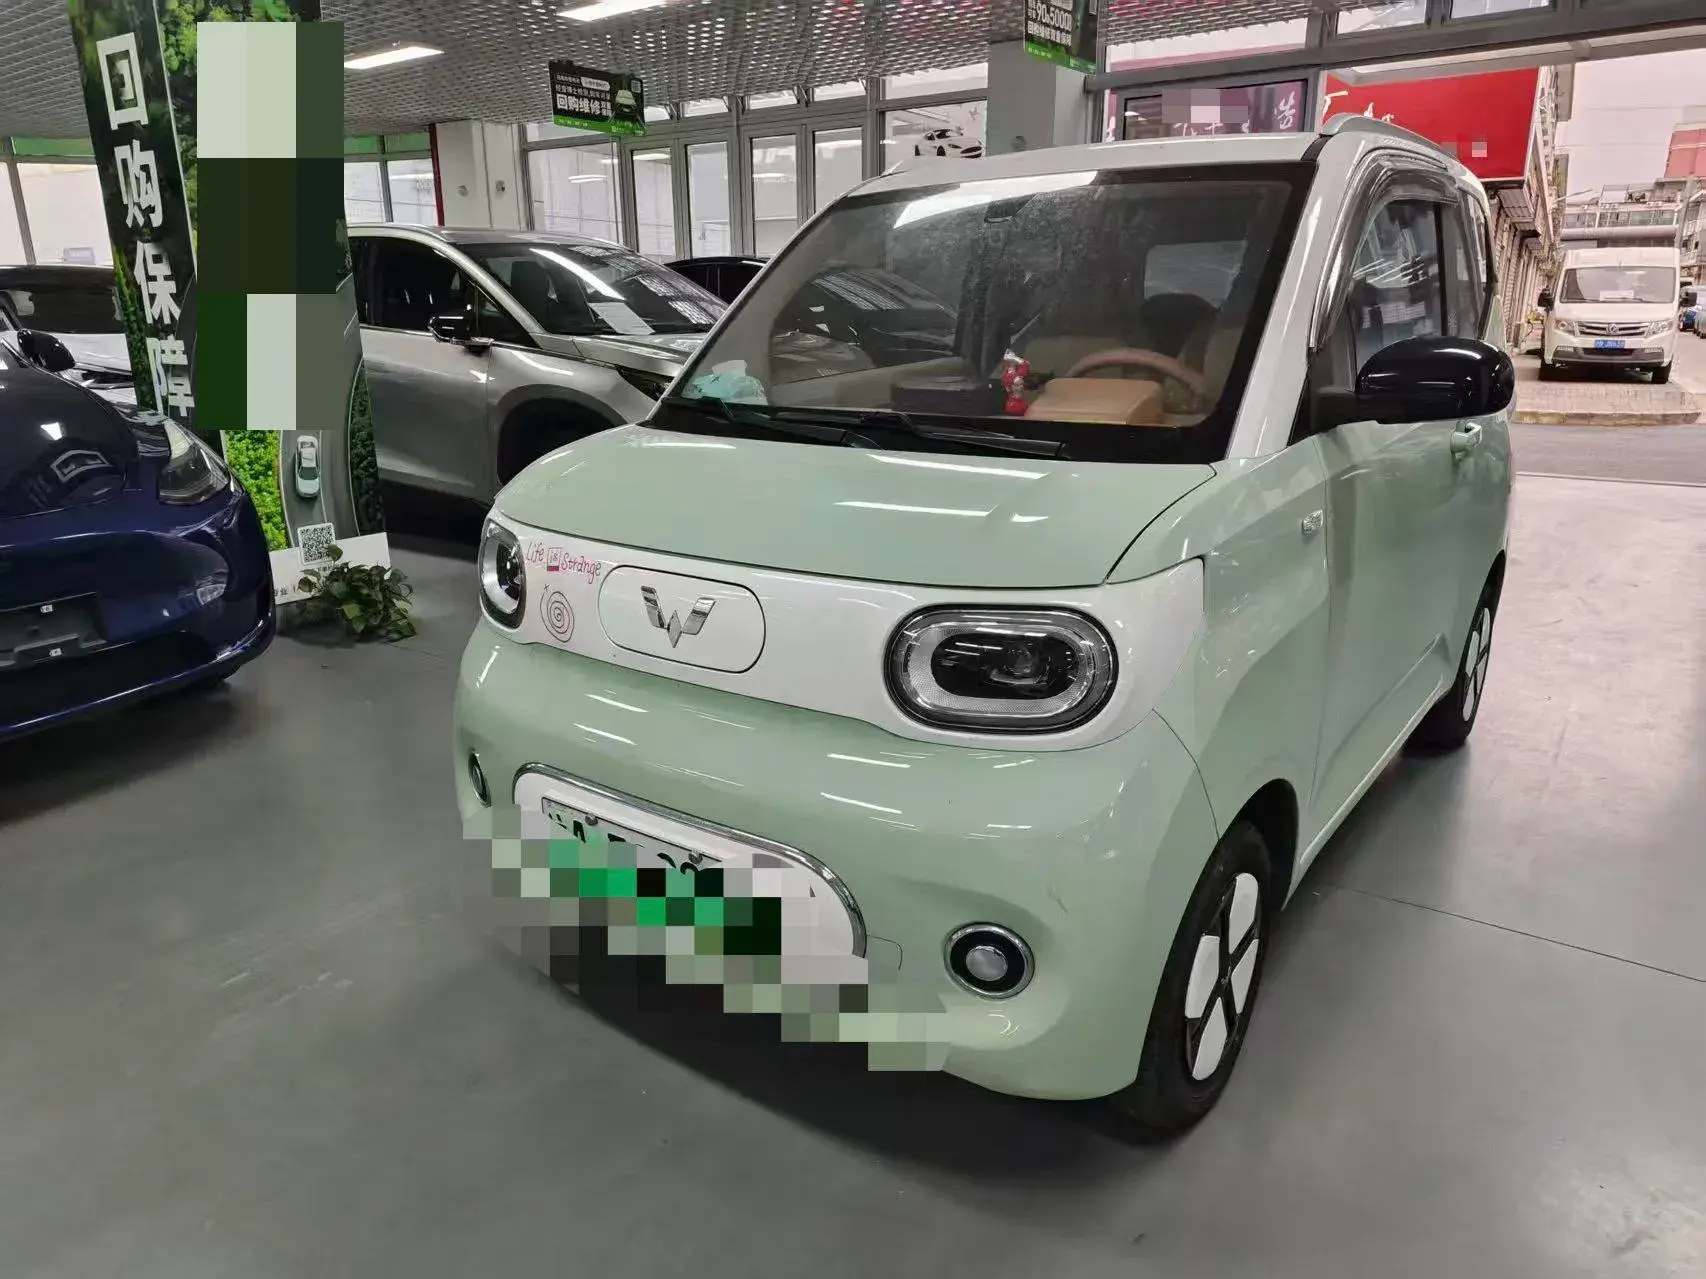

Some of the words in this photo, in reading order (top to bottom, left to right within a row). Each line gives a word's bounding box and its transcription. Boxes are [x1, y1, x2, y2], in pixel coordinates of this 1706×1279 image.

[556, 93, 601, 115] 回购维修
[96, 32, 195, 417] 回购保障
[526, 541, 544, 563] Life
[561, 552, 602, 584] Strange
